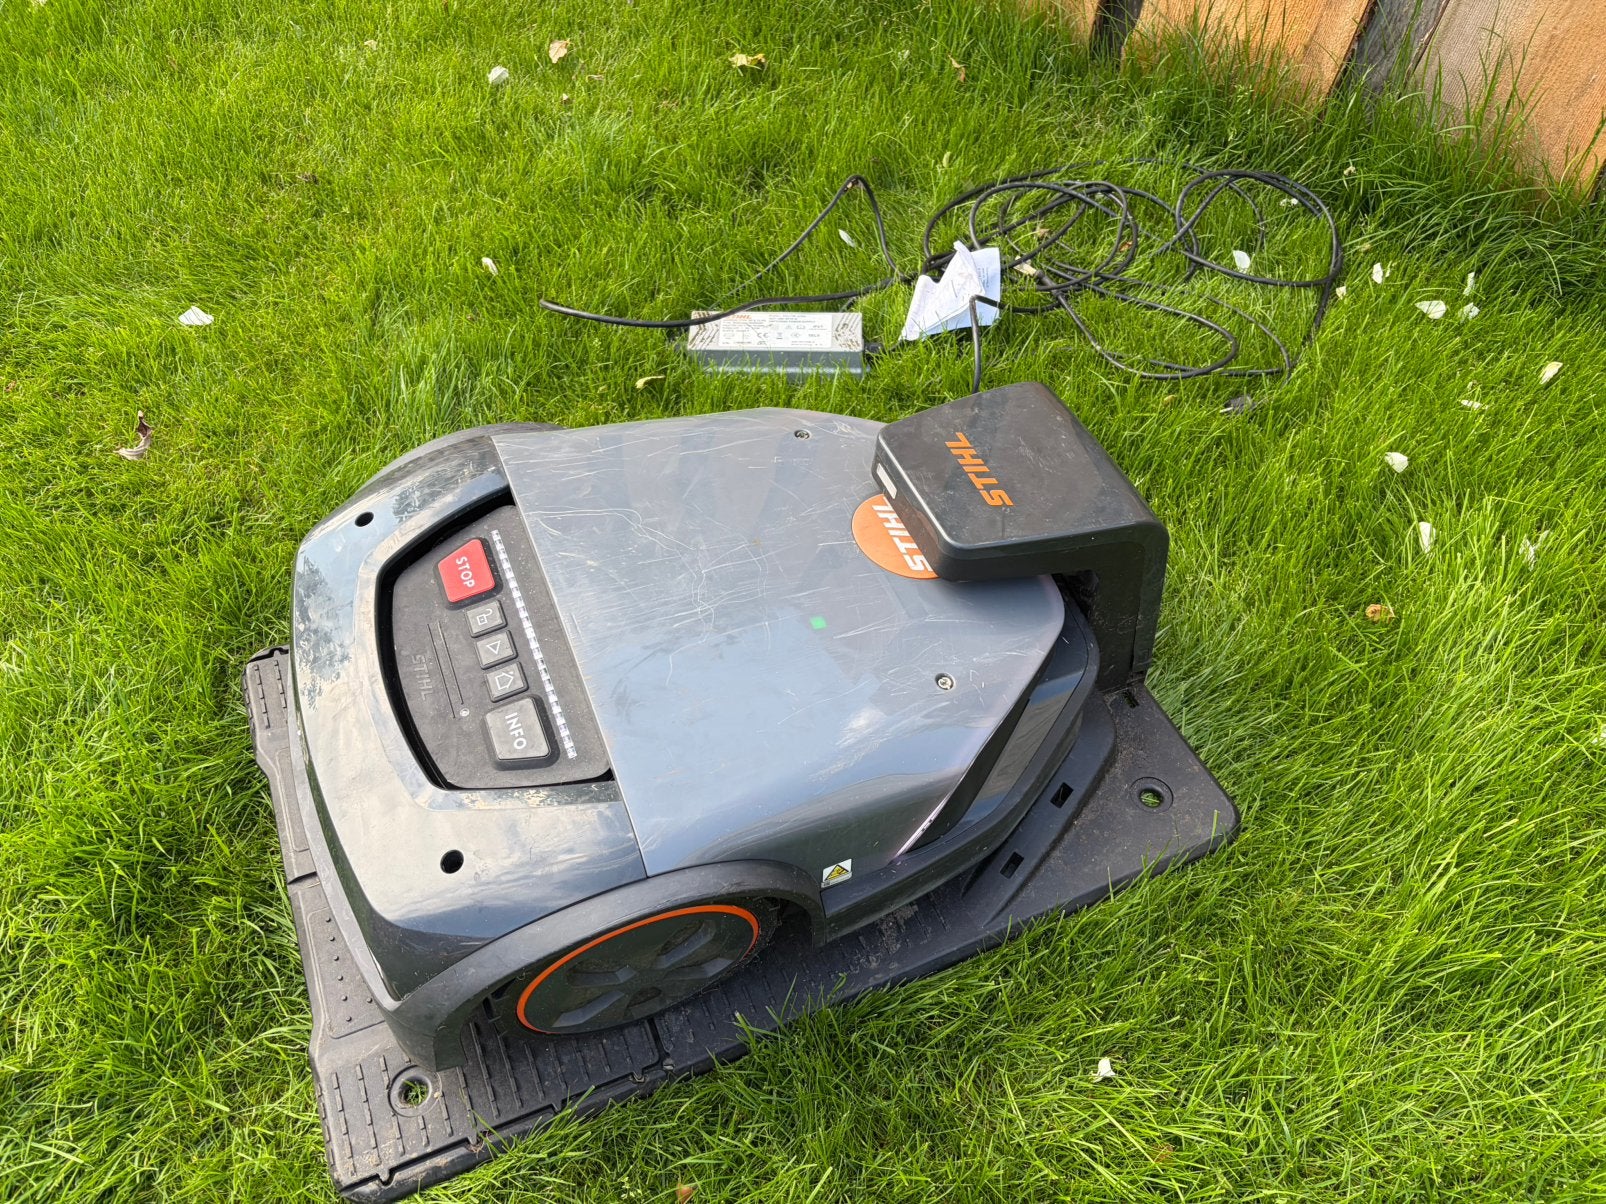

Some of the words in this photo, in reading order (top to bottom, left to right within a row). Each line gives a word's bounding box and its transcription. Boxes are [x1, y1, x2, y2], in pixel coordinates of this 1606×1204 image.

[944, 432, 1014, 506] STIHL
[455, 556, 476, 588] STOP
[411, 654, 433, 701] STIHL
[505, 712, 527, 750] INFO
